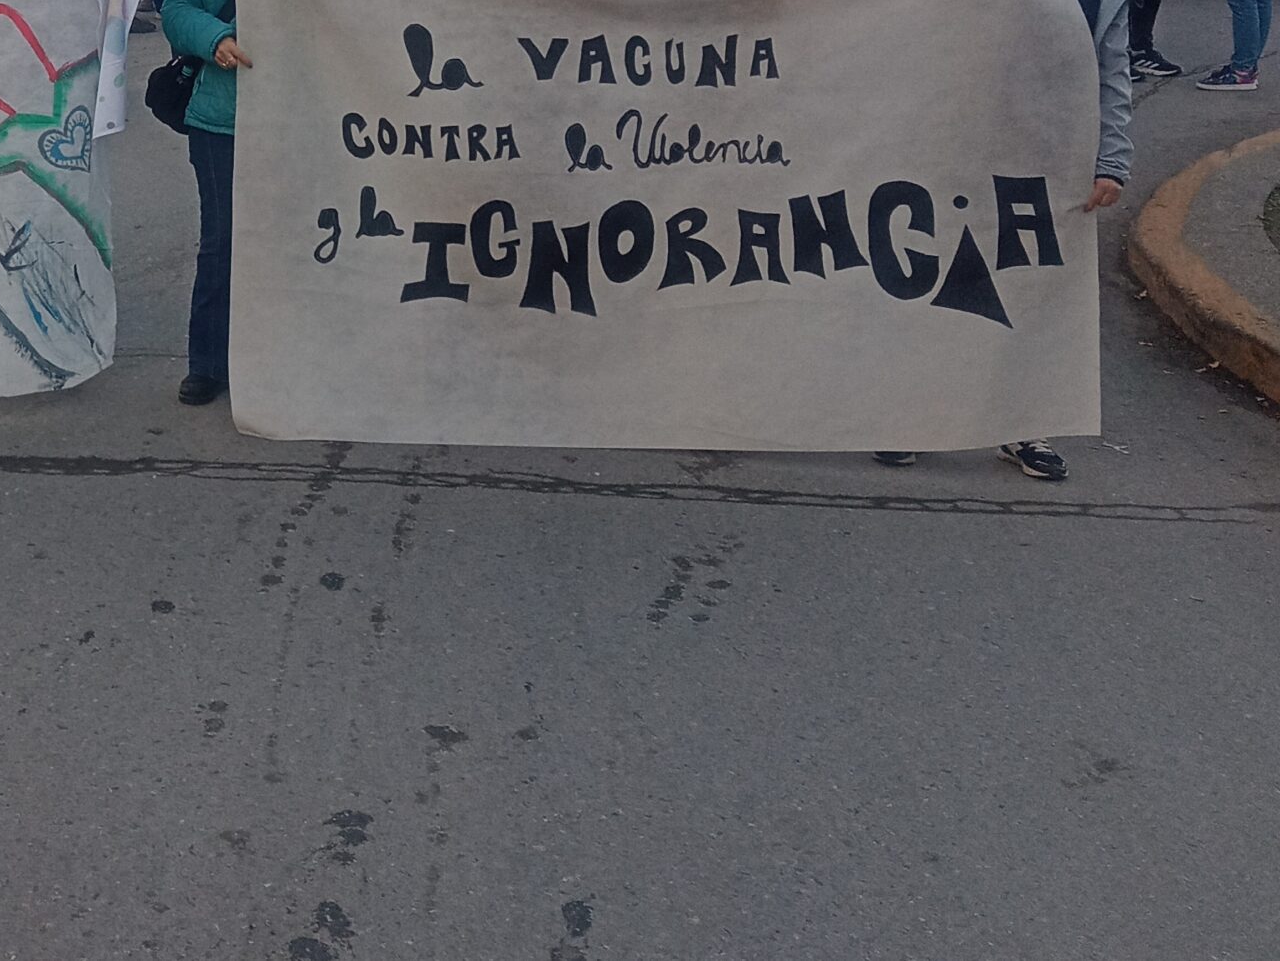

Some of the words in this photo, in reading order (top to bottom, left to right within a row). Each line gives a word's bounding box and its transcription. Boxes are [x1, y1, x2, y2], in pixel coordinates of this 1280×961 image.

[404, 23, 484, 97] la
[517, 34, 781, 87] VACUNA
[341, 112, 521, 162] CONTRA
[564, 122, 613, 173] la
[616, 108, 791, 169] Violencia
